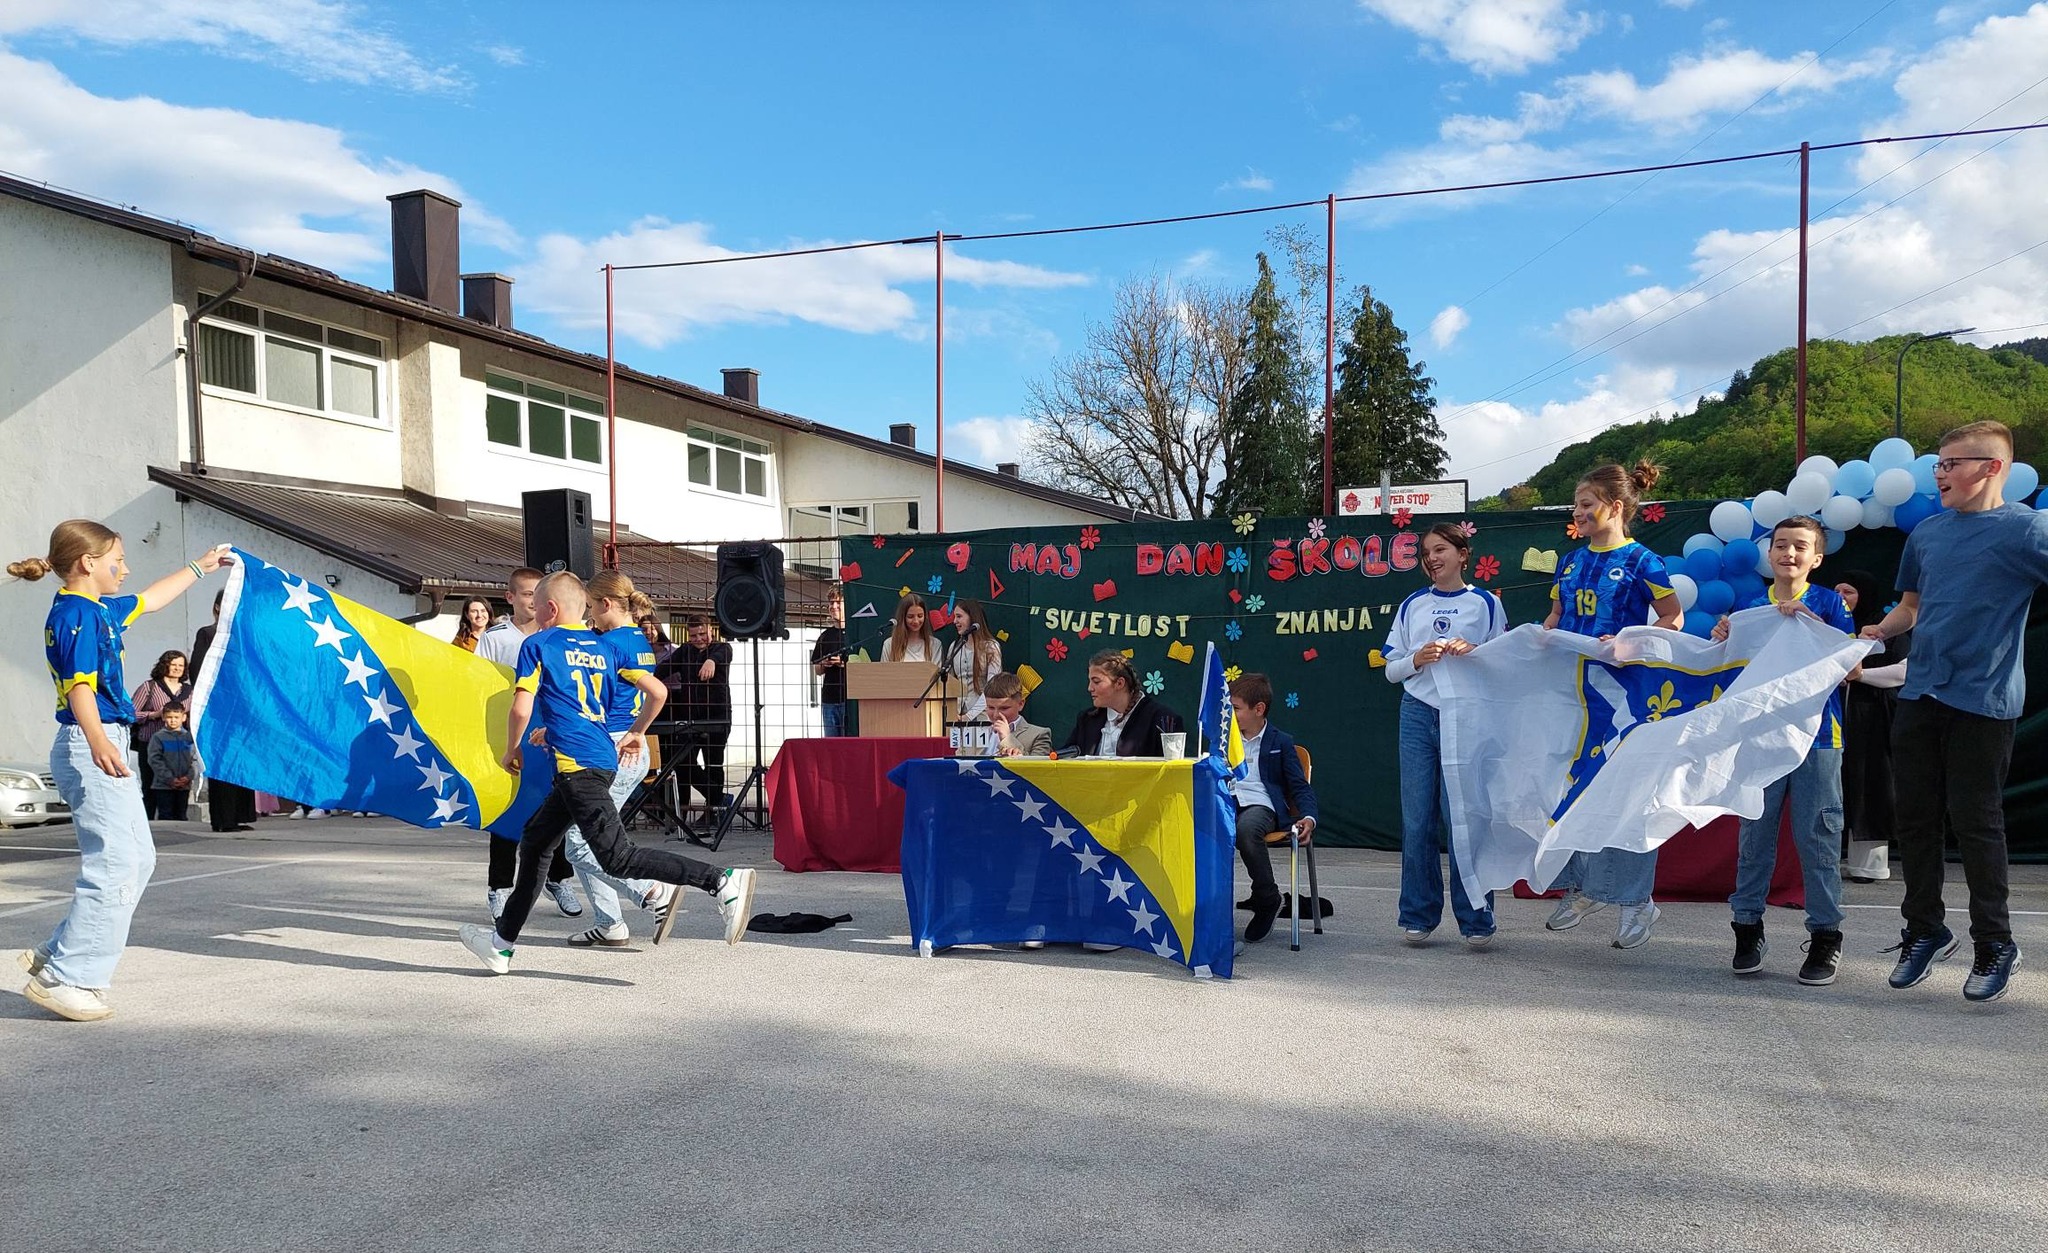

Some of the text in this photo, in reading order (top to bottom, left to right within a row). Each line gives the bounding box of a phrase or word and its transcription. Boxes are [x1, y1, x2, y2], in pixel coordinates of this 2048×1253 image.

[1374, 495, 1405, 509] NVER
[1406, 493, 1430, 506] STOP
[946, 534, 1419, 582] 9 MAJ DAN ŠKOLE
[1576, 588, 1598, 616] 19
[564, 648, 607, 670] DŽEKO
